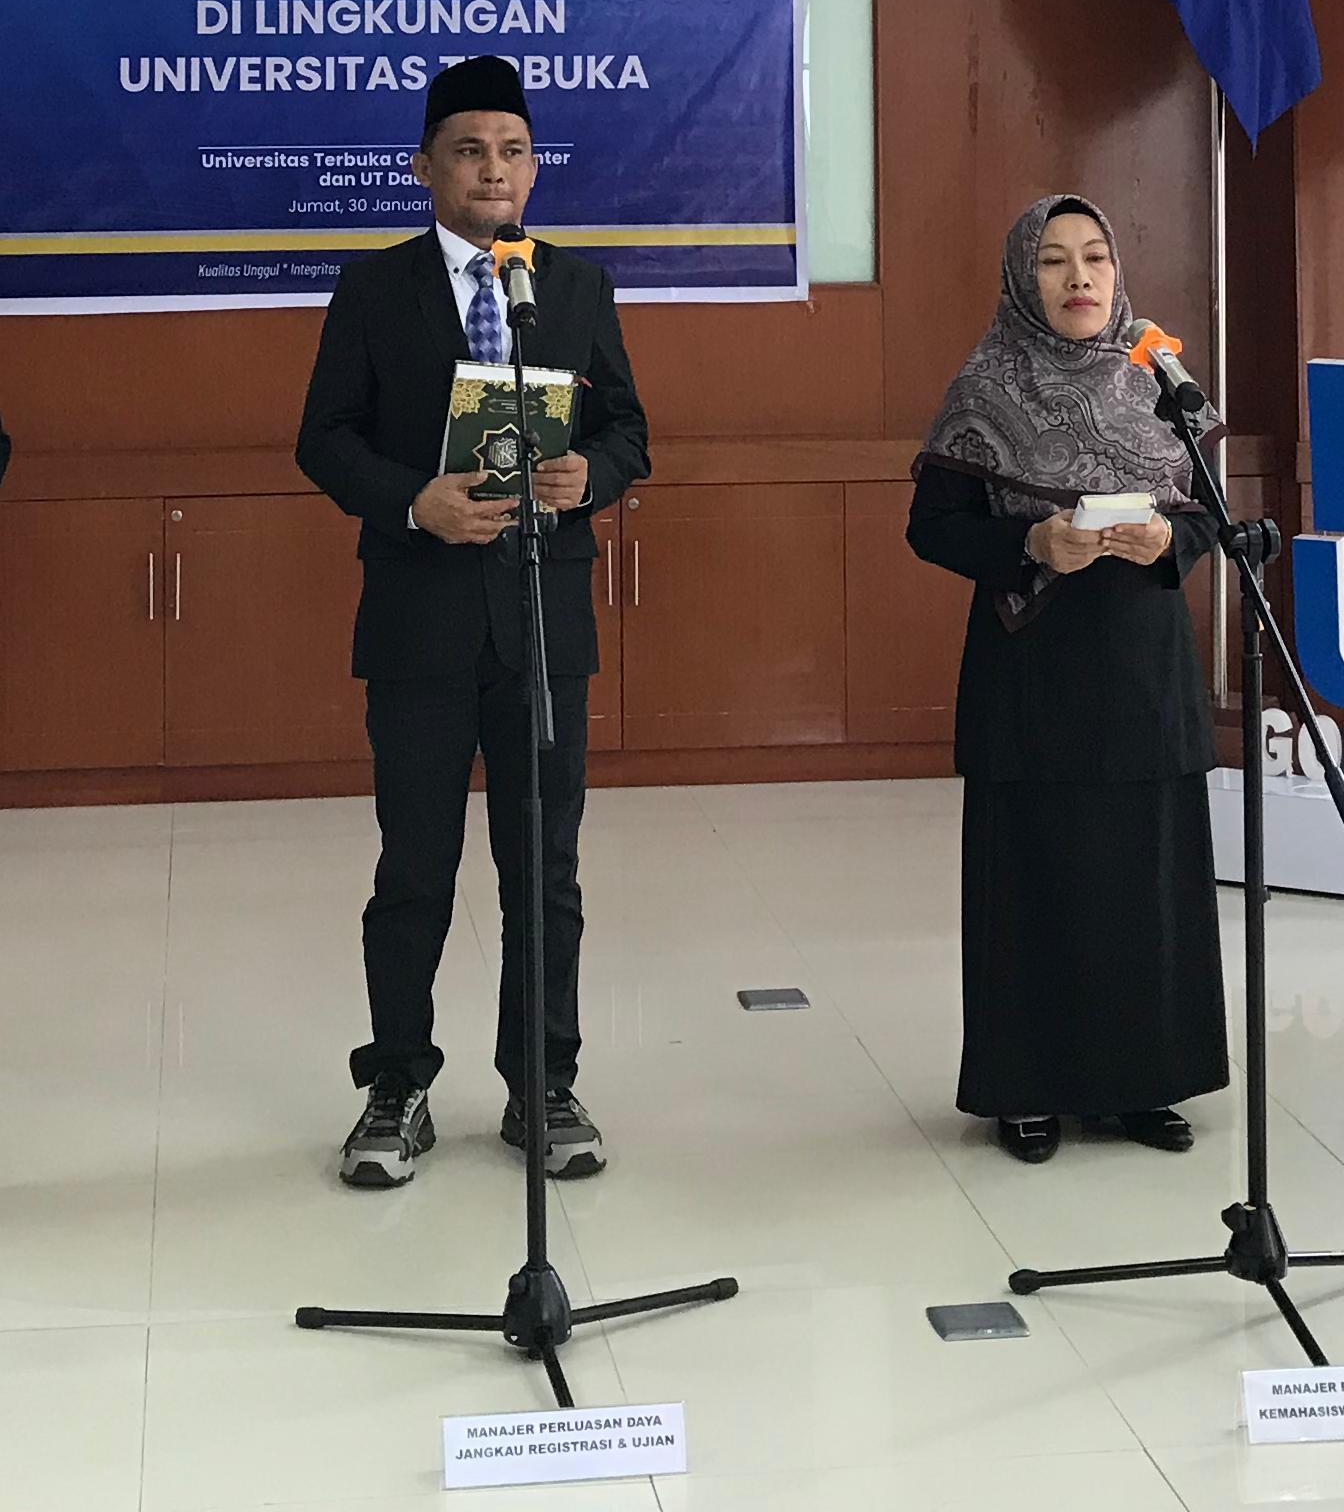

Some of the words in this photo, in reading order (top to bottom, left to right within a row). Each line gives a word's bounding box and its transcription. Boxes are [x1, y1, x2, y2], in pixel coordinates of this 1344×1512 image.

[197, 0, 241, 34] DI
[119, 54, 427, 91] UNIVERSITAS
[439, 55, 650, 90] BUKA
[202, 152, 309, 168] Universitas
[314, 151, 391, 167] Terbuka
[319, 171, 356, 187] dan
[360, 171, 385, 186] UT
[288, 198, 344, 214] Jumat,
[348, 197, 368, 212] 30
[372, 196, 432, 212] Januari
[198, 264, 241, 277] Kualitas
[243, 263, 280, 279] Unggul
[290, 262, 341, 278] Integritas
[1272, 1381, 1336, 1396] MANAJER
[467, 1424, 535, 1439] MANAJER
[539, 1418, 622, 1434] PERLUASAN
[627, 1415, 662, 1428] DAYA
[456, 1445, 523, 1460] JANGKAU
[529, 1439, 612, 1456] REGISTRASI
[618, 1438, 627, 1449] &
[632, 1434, 675, 1448] UJIAN
